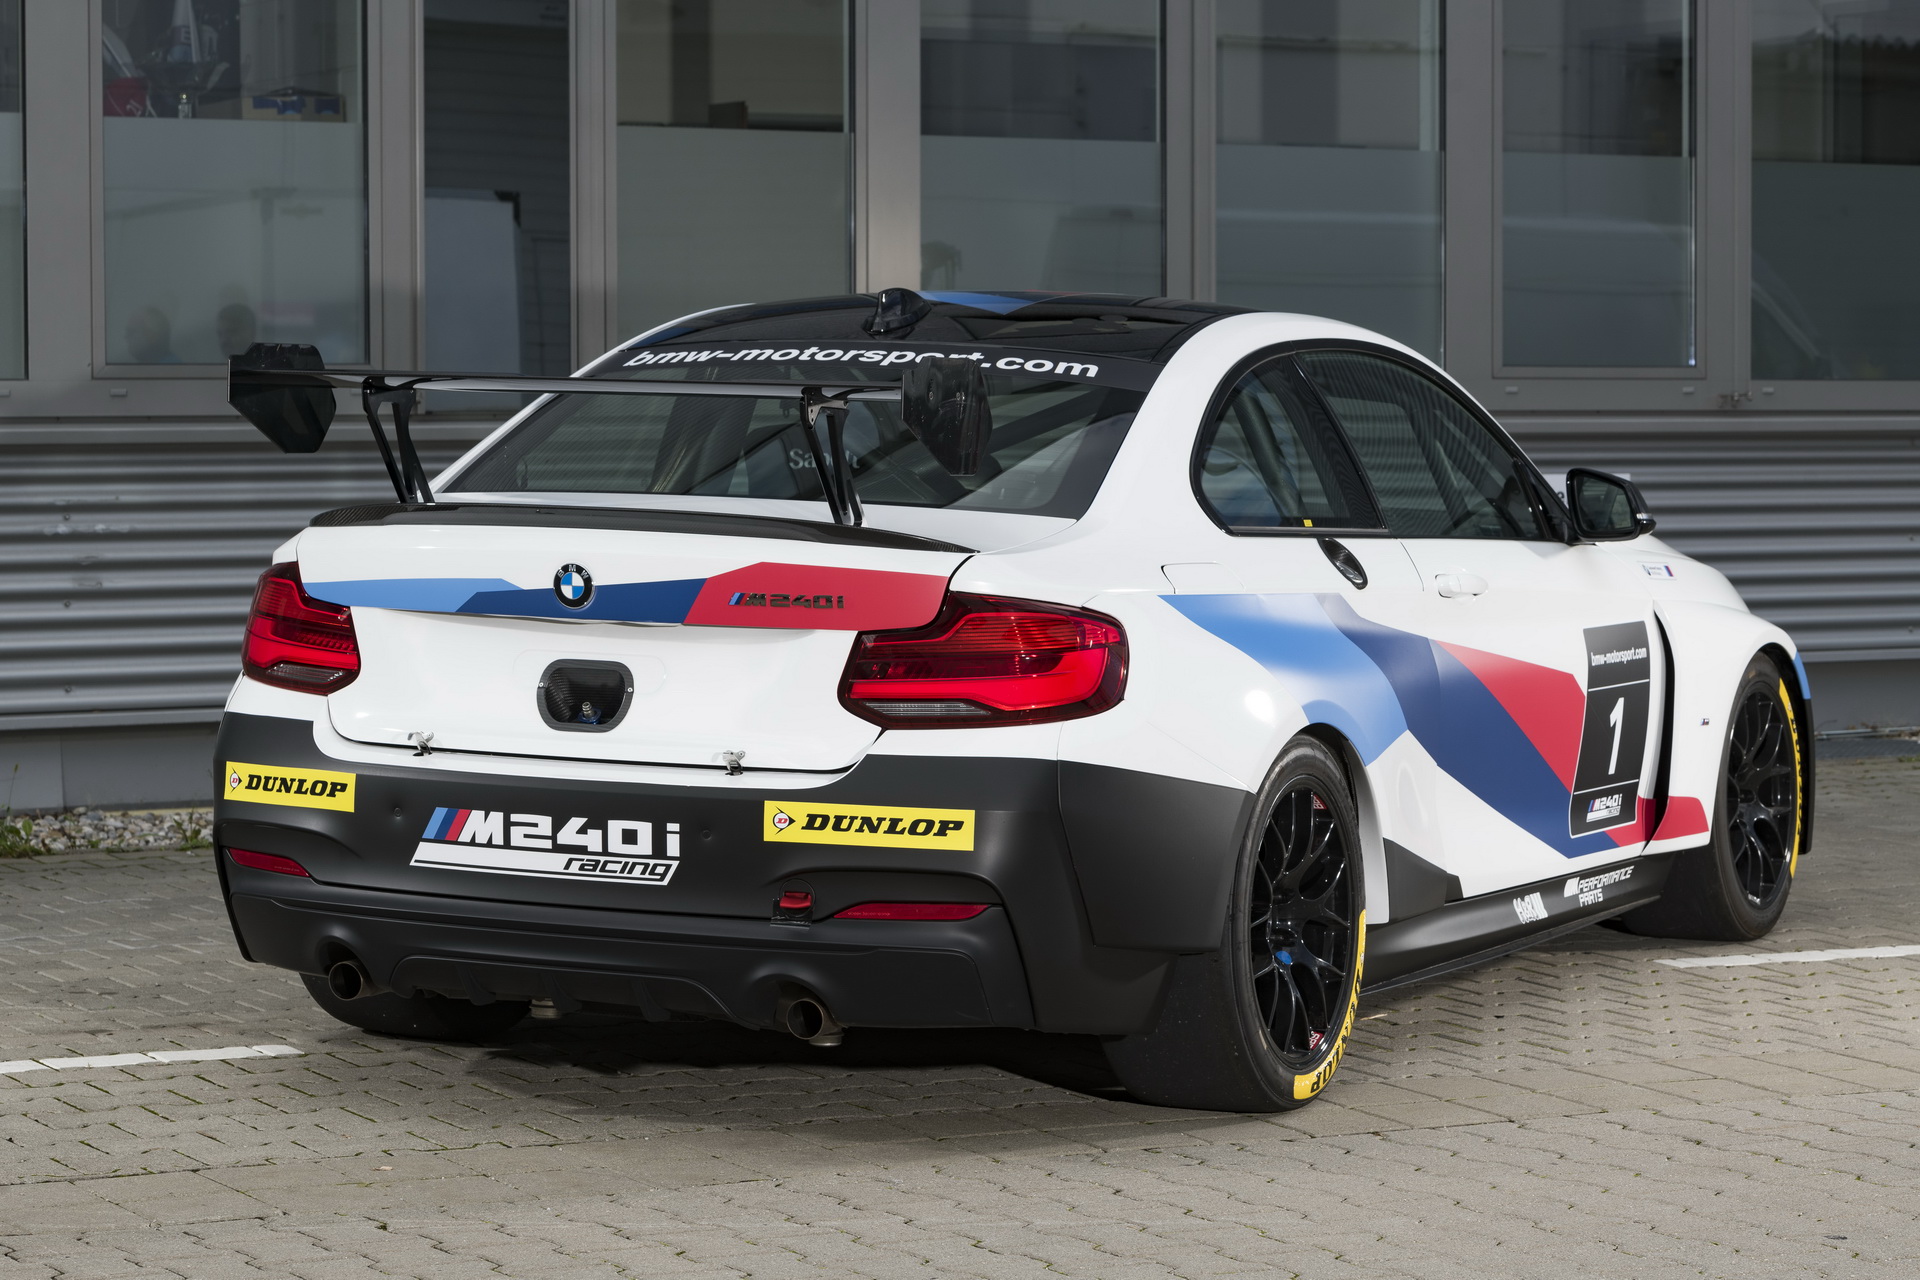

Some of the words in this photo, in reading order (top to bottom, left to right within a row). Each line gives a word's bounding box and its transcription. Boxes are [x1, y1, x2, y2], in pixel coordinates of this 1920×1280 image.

[557, 564, 589, 580] BMW
[745, 592, 844, 609] M240i
[1590, 646, 1647, 667] bmw-motorsport.com
[1609, 696, 1624, 776] 1
[244, 773, 349, 798] DUNLOP
[1591, 792, 1623, 812] M240i
[458, 809, 681, 857] M240i
[801, 813, 965, 837] DUNLOP
[562, 856, 672, 881] racing
[1578, 865, 1635, 893] PERFORMANCE
[1579, 888, 1604, 907] PARTS
